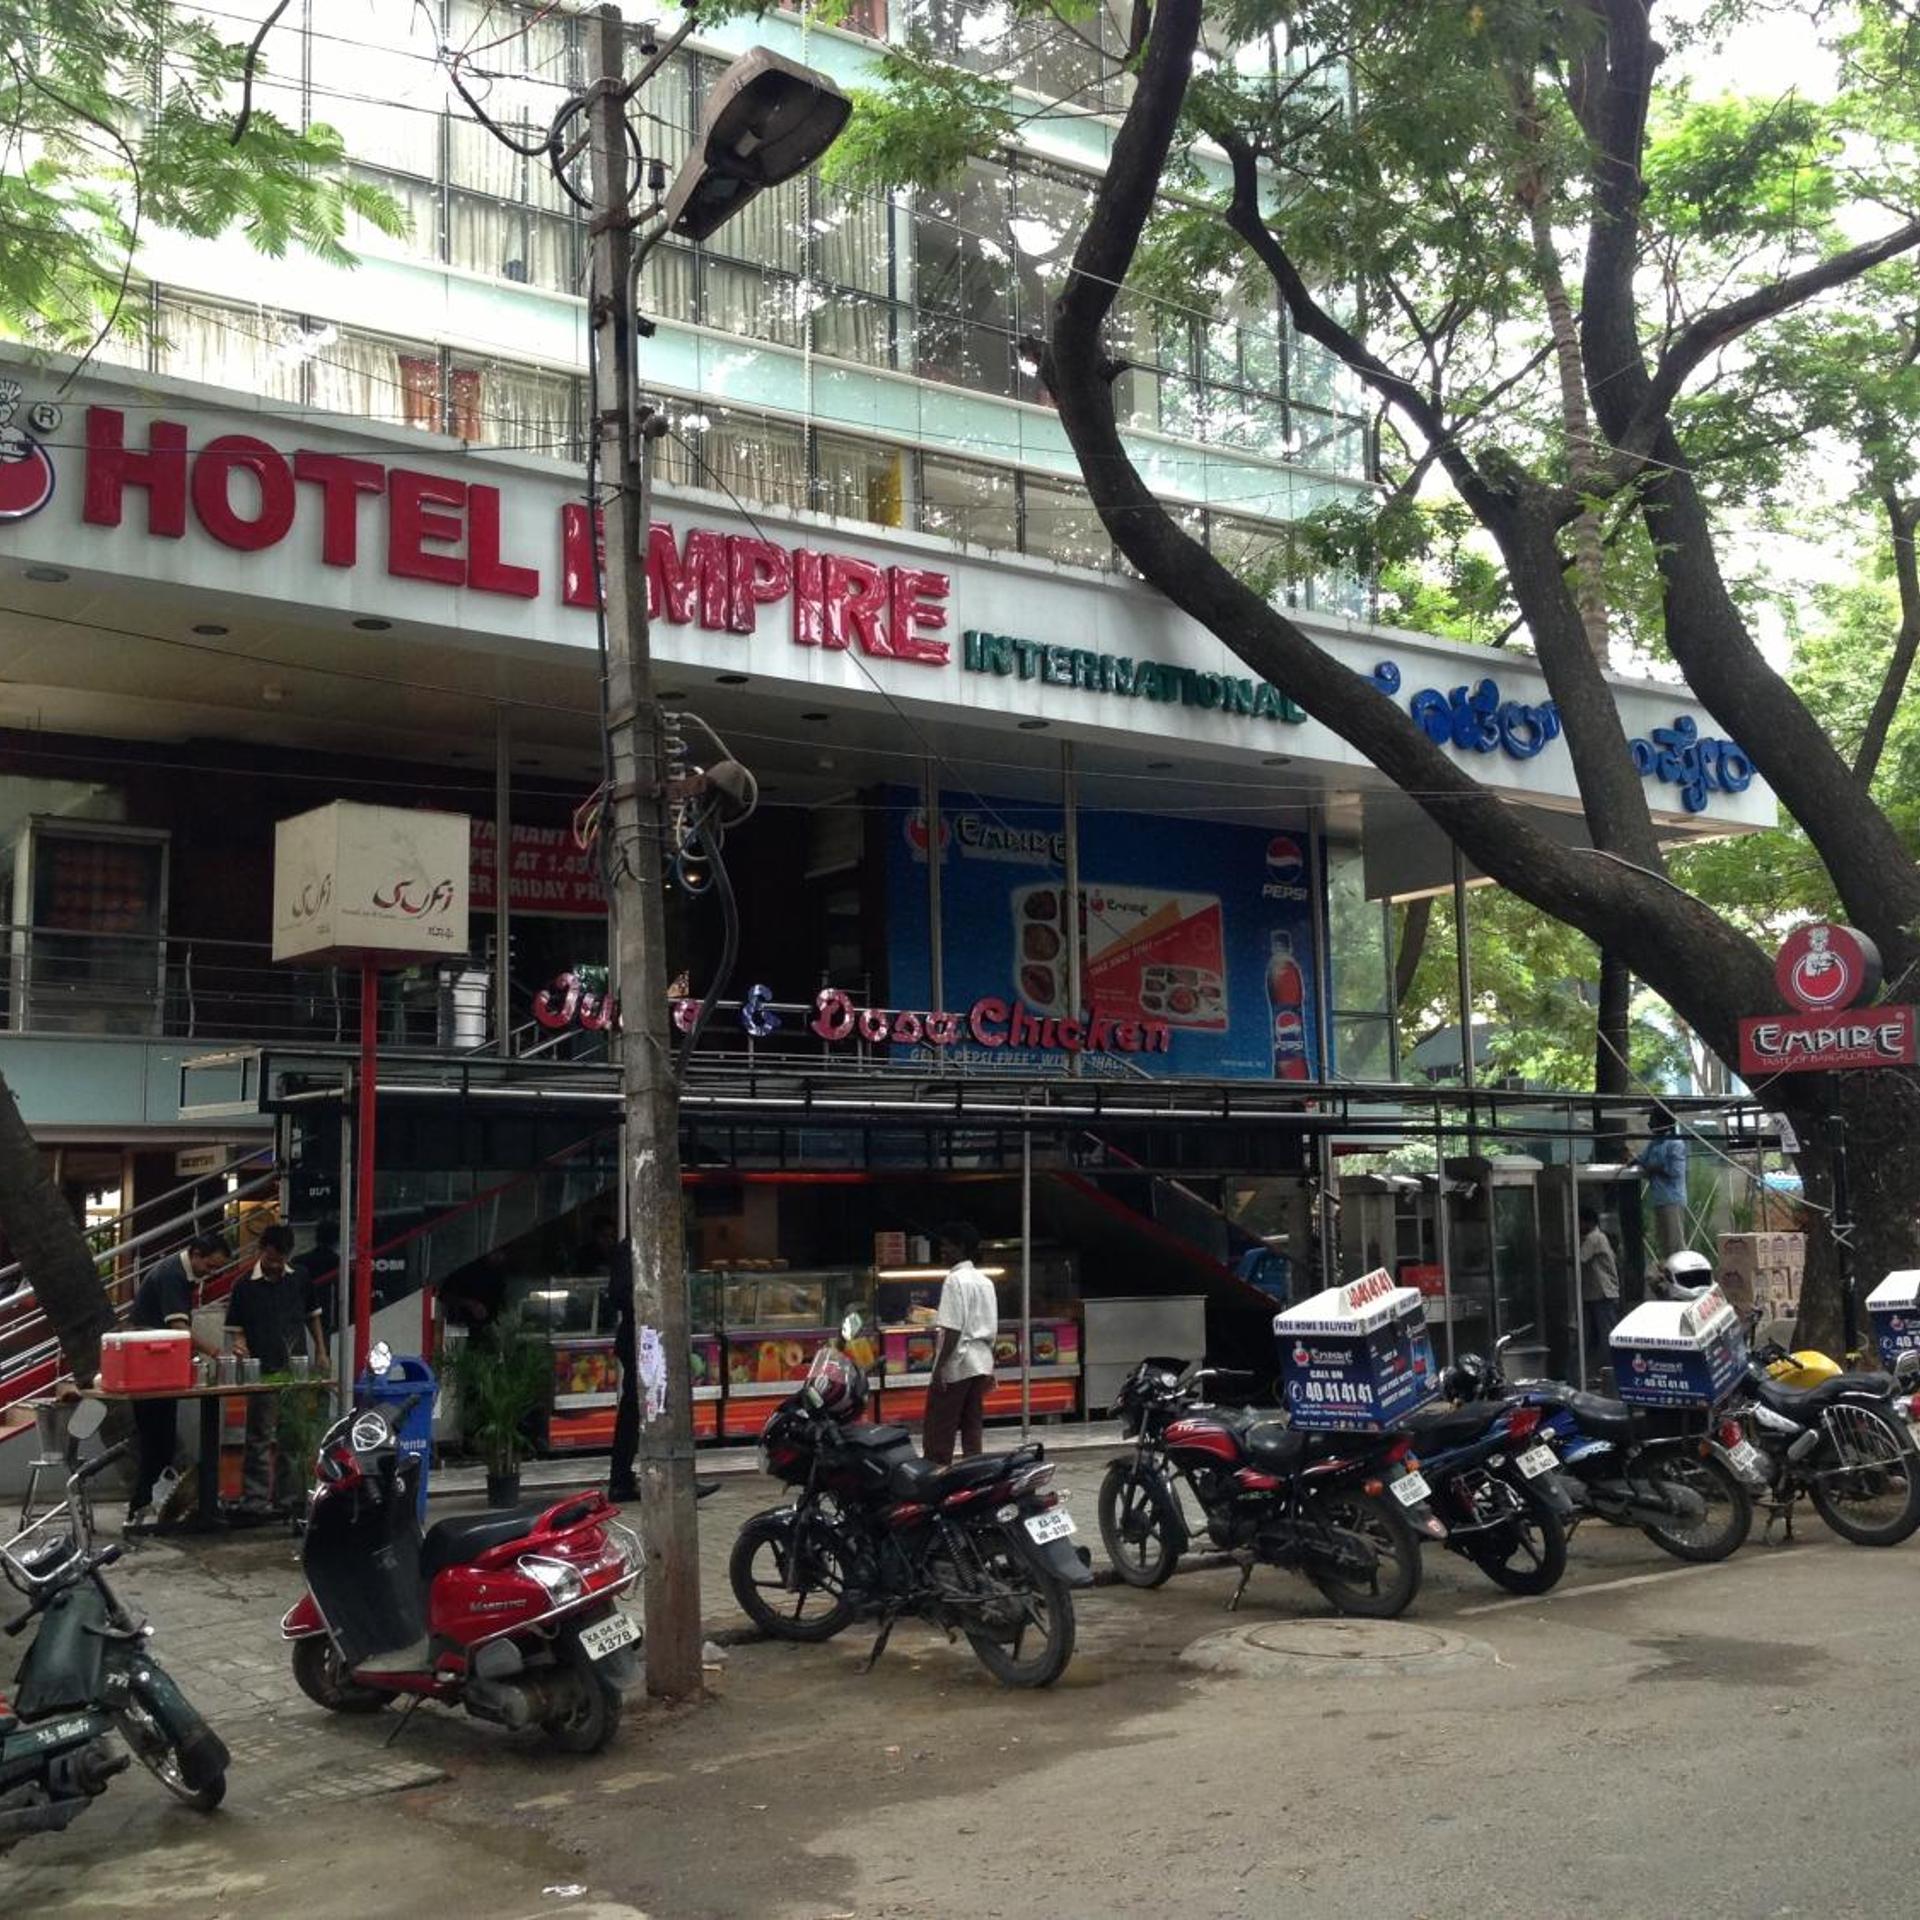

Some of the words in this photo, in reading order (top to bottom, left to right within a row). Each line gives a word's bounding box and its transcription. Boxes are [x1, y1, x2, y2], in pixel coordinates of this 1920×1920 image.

[83, 404, 539, 598] HOTEL
[963, 629, 1307, 724] INTERNATIONAL
[507, 877, 568, 900] RIDAY
[1262, 883, 1308, 900] PEPSI
[810, 987, 957, 1044] Dosa
[969, 997, 1171, 1053] Chicken
[1752, 1023, 1905, 1058] EMPIRE
[1275, 1321, 1294, 1331] FREE
[1296, 1321, 1317, 1331] HOME
[1319, 1321, 1358, 1332] DELIVERY
[1305, 1382, 1324, 1402] 40
[1325, 1383, 1341, 1402] 41
[1341, 1383, 1357, 1403] 41
[1358, 1384, 1374, 1403] 41
[598, 1630, 633, 1653] 4378
